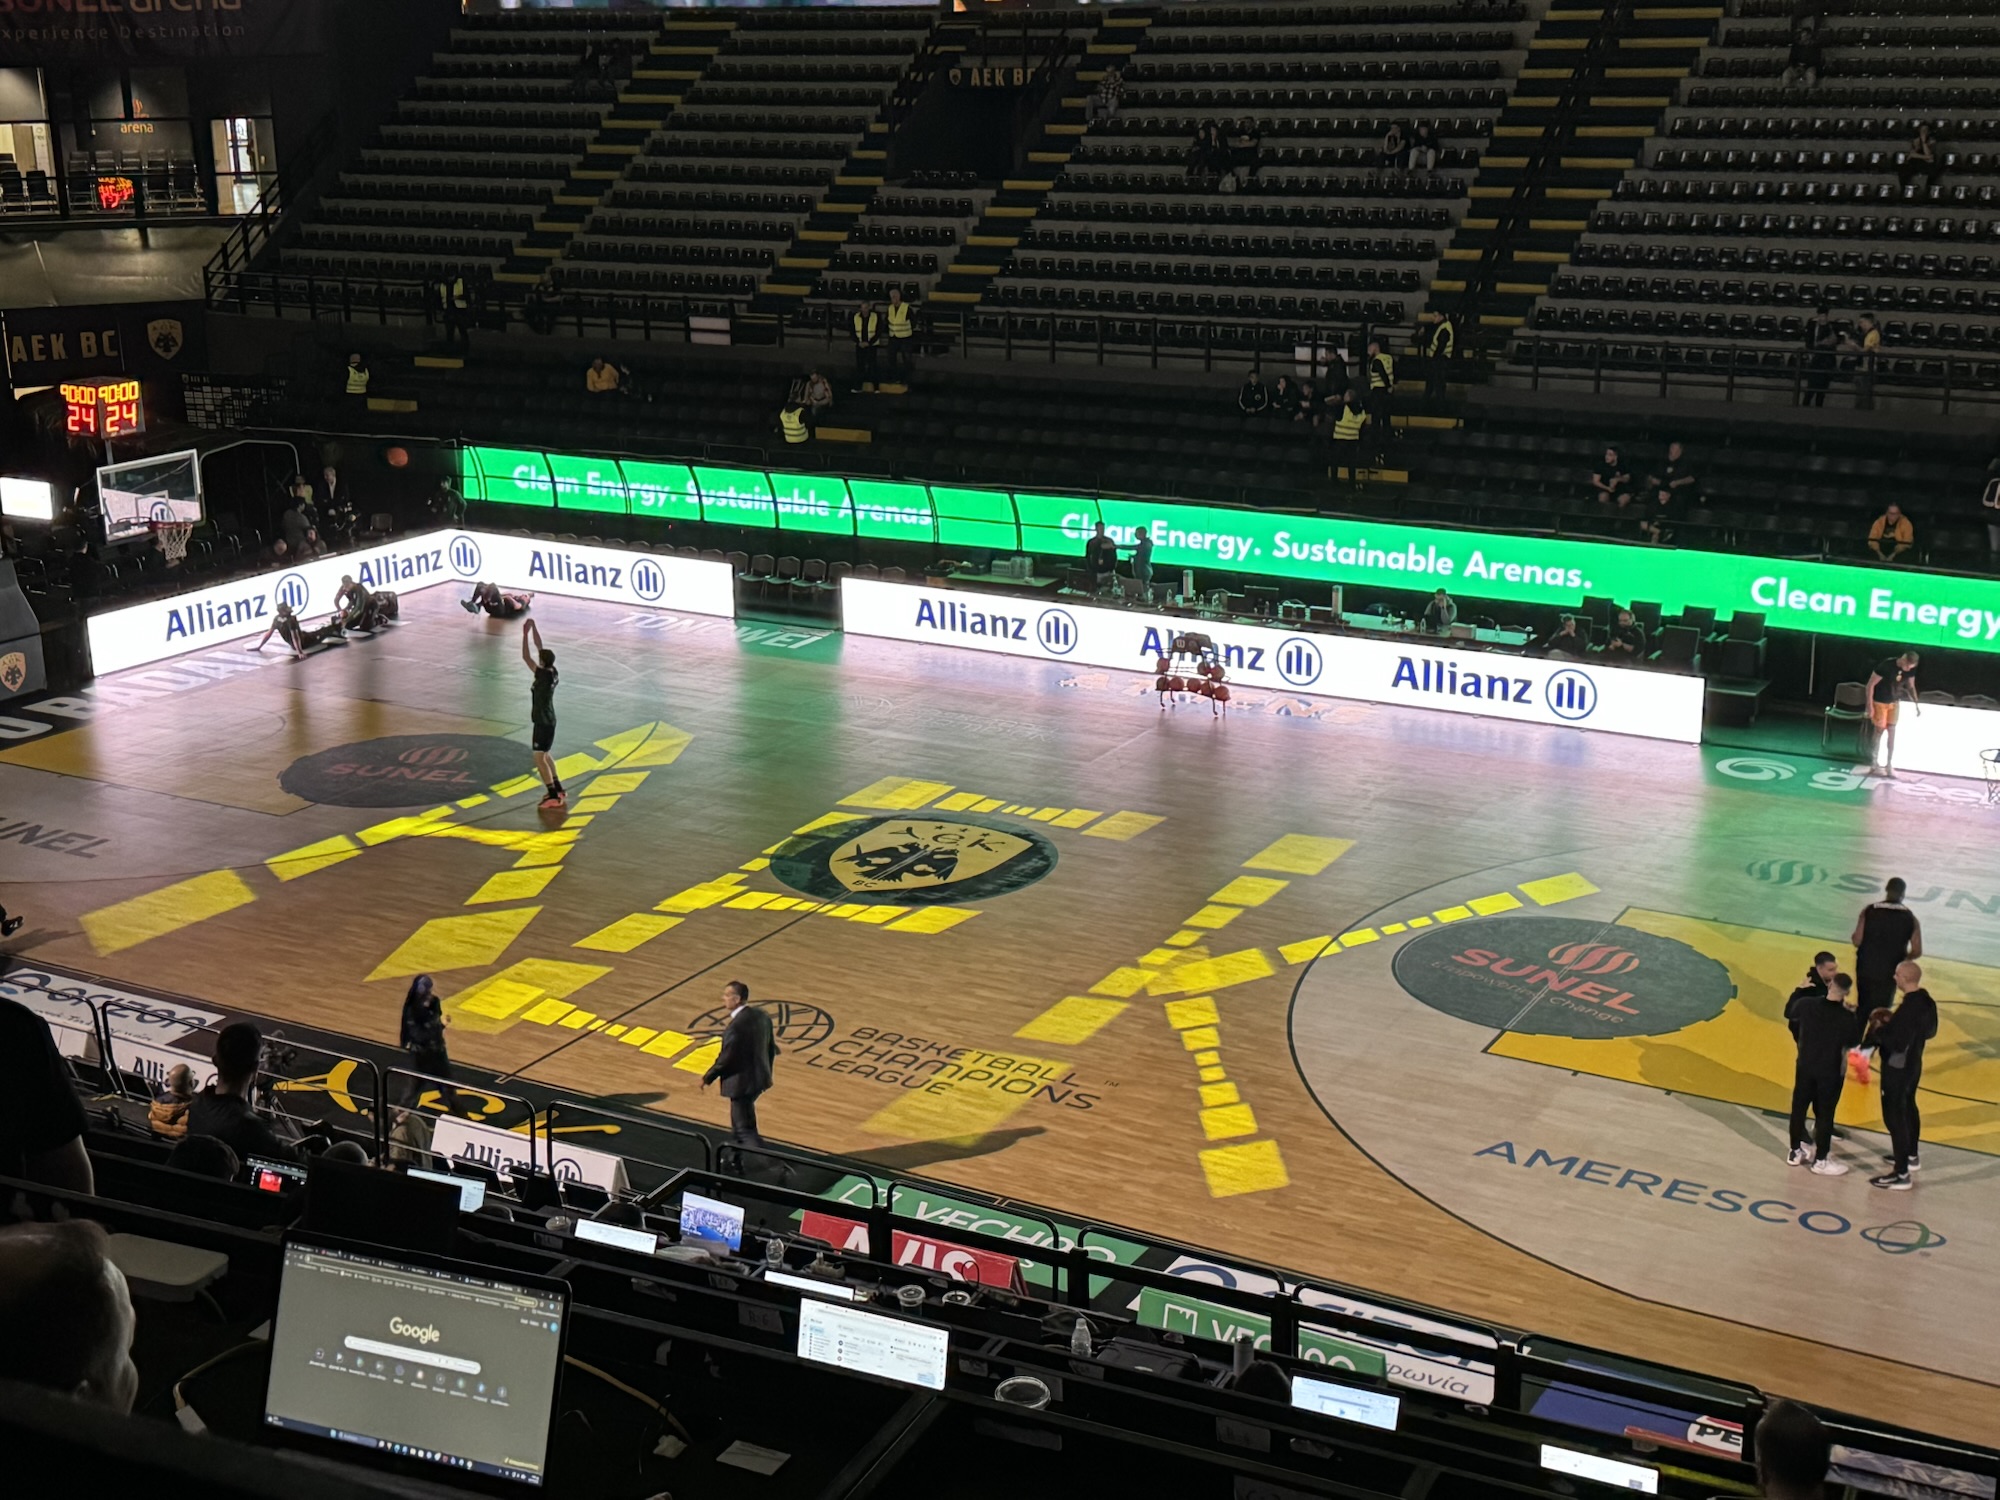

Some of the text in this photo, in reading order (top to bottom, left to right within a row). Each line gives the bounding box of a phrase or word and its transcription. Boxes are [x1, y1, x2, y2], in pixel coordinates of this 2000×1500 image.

[970, 67, 1006, 87] AEK
[120, 122, 155, 134] arena
[12, 328, 119, 363] AEK BC
[68, 405, 94, 432] 24
[106, 403, 137, 432] 24
[513, 464, 577, 495] Clean
[587, 472, 678, 508] Energy.
[685, 477, 830, 518] Sustainable
[358, 547, 444, 588] Allianz
[528, 549, 623, 590] Allianz
[1061, 512, 1593, 589] Clan Energy. Sustainable Arenas.
[1751, 576, 1857, 616] Clean
[165, 592, 268, 643] Allianz
[915, 598, 1028, 641] Allianz
[1391, 656, 1533, 704] Allianz
[326, 762, 478, 784] SUNEL
[1451, 947, 1641, 1016] SUNEL
[1549, 996, 1624, 1024] Change
[806, 1053, 955, 1097] LEAGUE
[828, 1040, 1102, 1112] CHAMPIONS
[848, 1026, 1081, 1088] BASKETBALL
[1472, 1140, 1852, 1236] AMERESCO
[390, 1316, 441, 1345] Google
